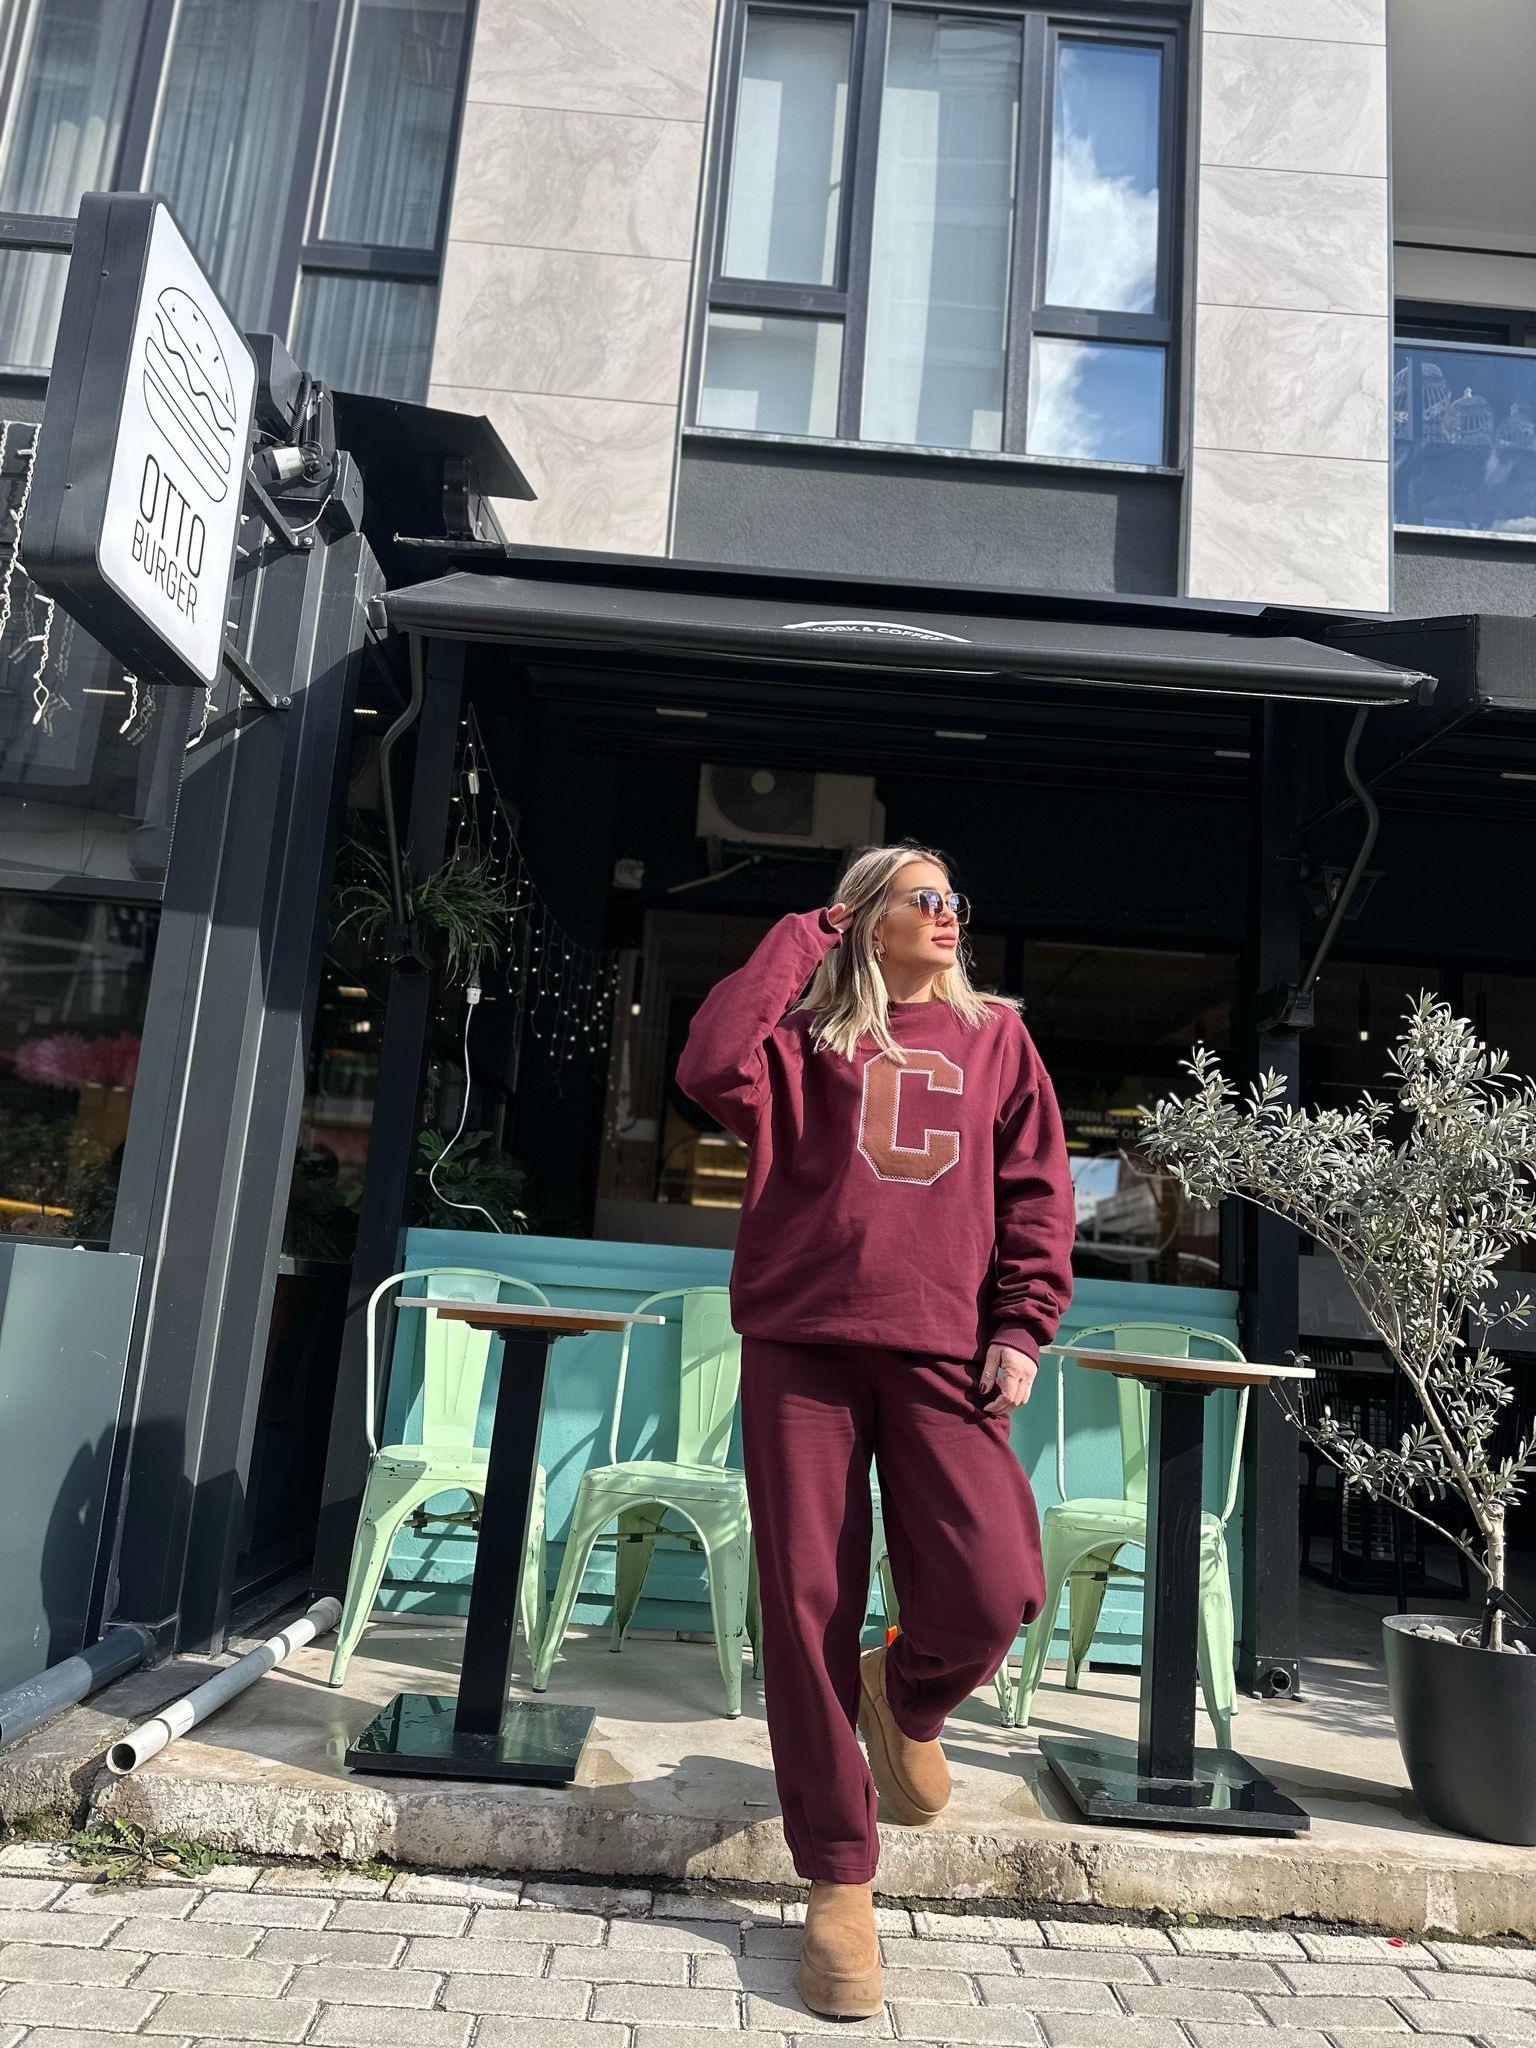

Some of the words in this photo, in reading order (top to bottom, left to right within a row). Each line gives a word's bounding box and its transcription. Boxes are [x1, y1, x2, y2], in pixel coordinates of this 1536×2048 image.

[132, 519, 198, 624] BURGER
[140, 454, 206, 578] OTTO
[857, 1048, 964, 1186] C
